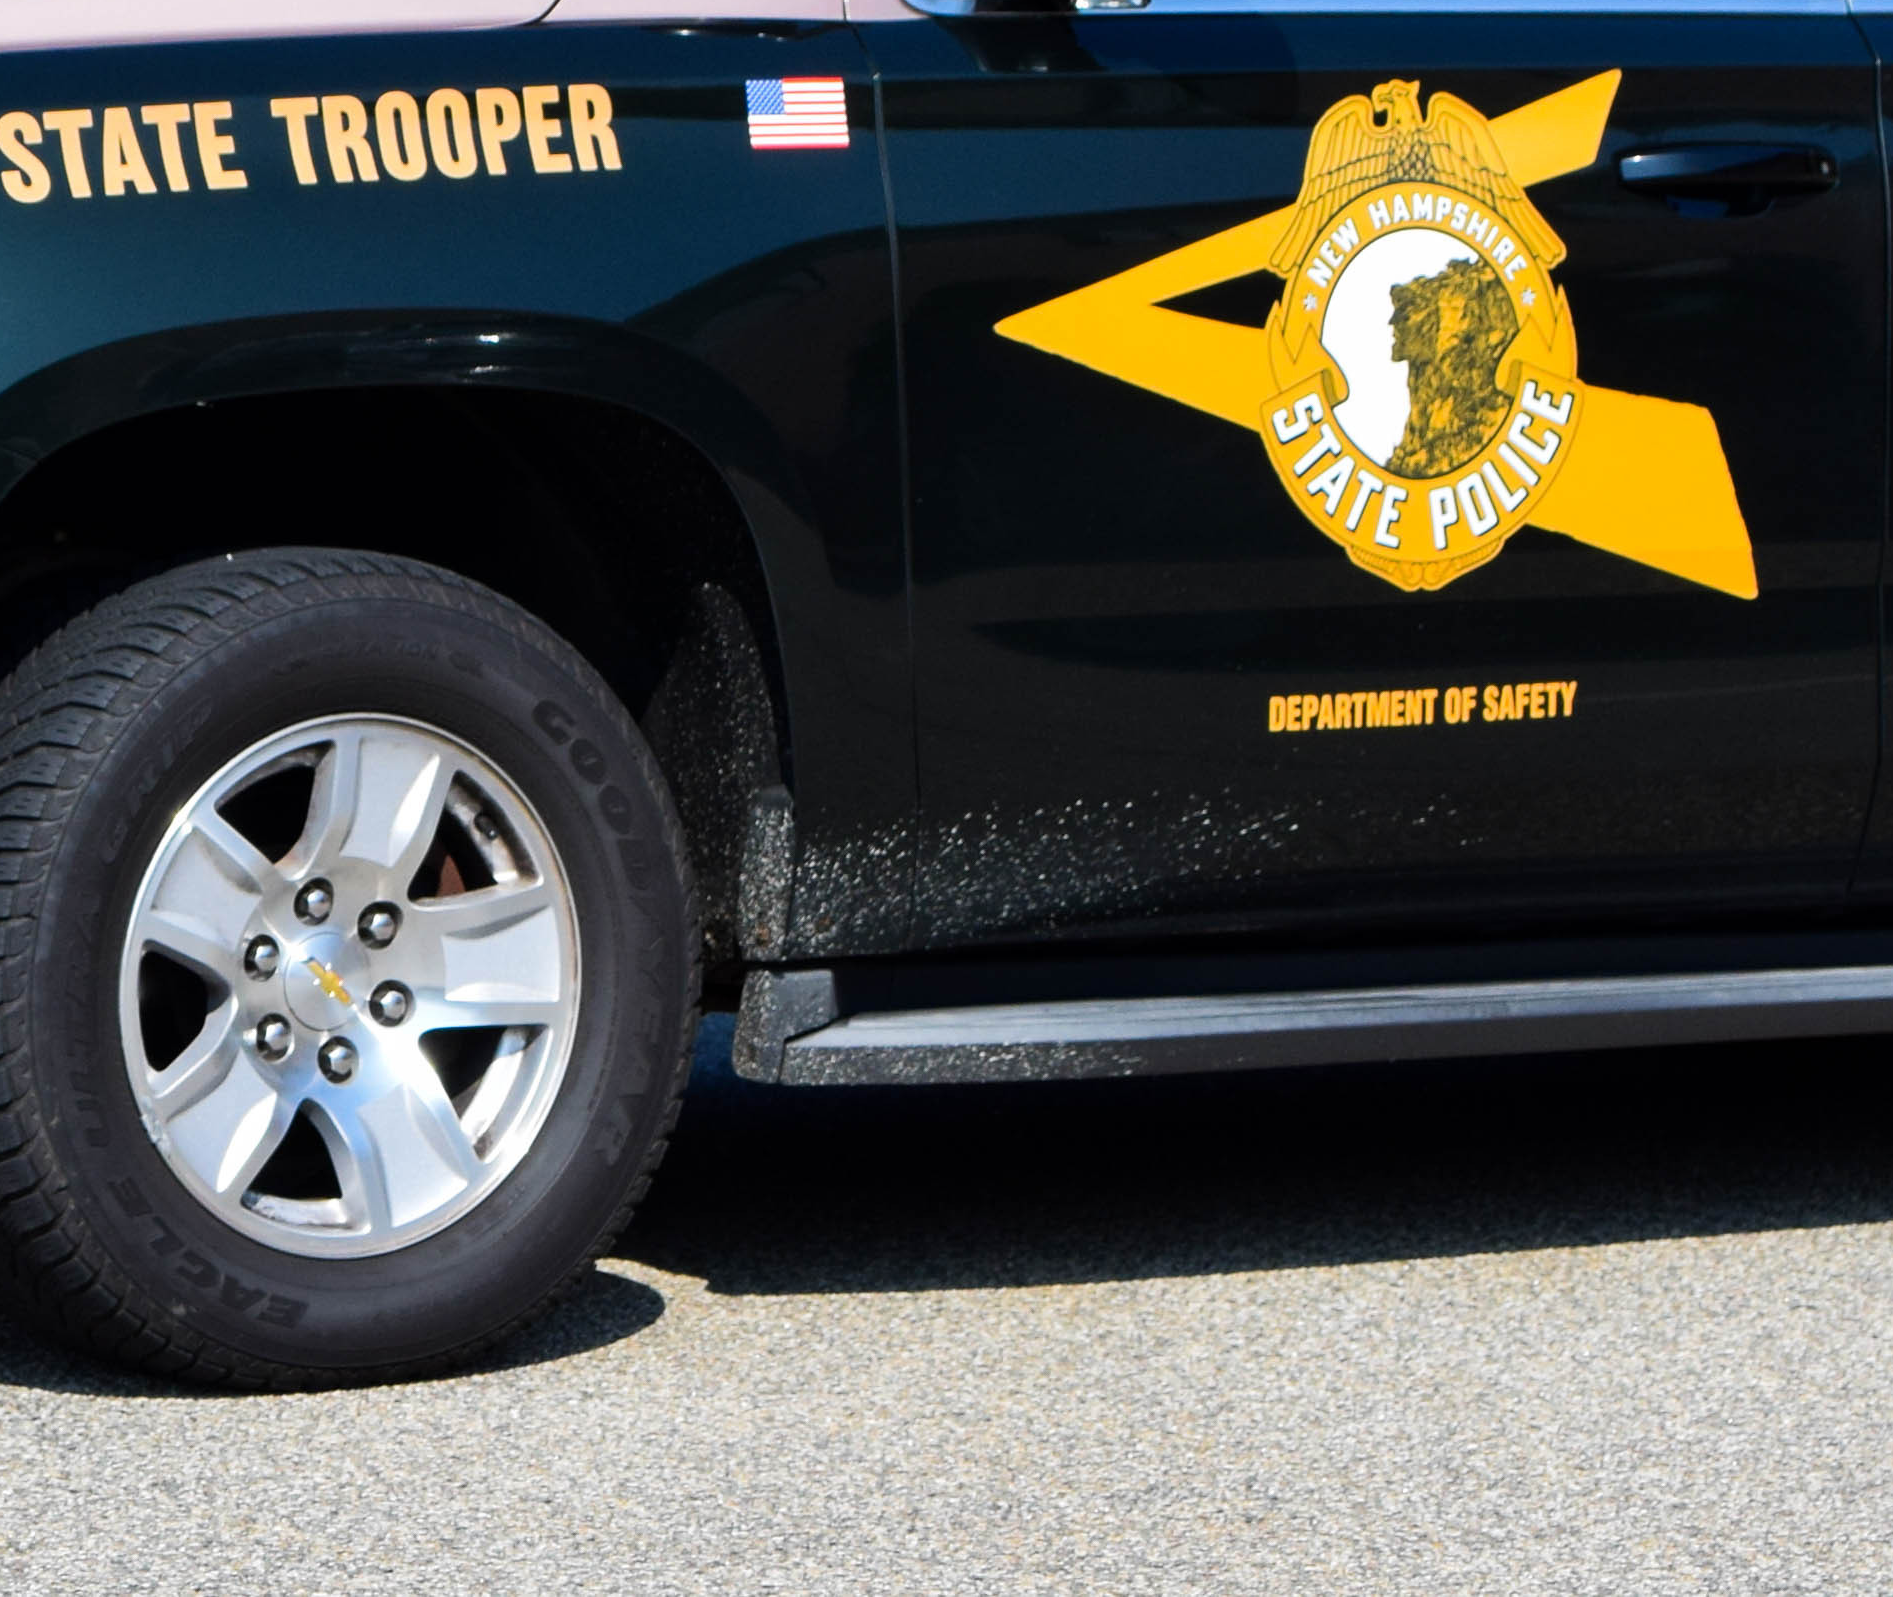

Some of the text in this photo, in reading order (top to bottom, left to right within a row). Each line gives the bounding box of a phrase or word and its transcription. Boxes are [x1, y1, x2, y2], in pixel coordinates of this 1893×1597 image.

[270, 83, 622, 187] TROOPER
[1306, 193, 1527, 288] NEW HAMPSHIRE
[1272, 380, 1575, 551] STATE POLICE
[1268, 681, 1577, 732] DEPARTMENT OF SAFETY
